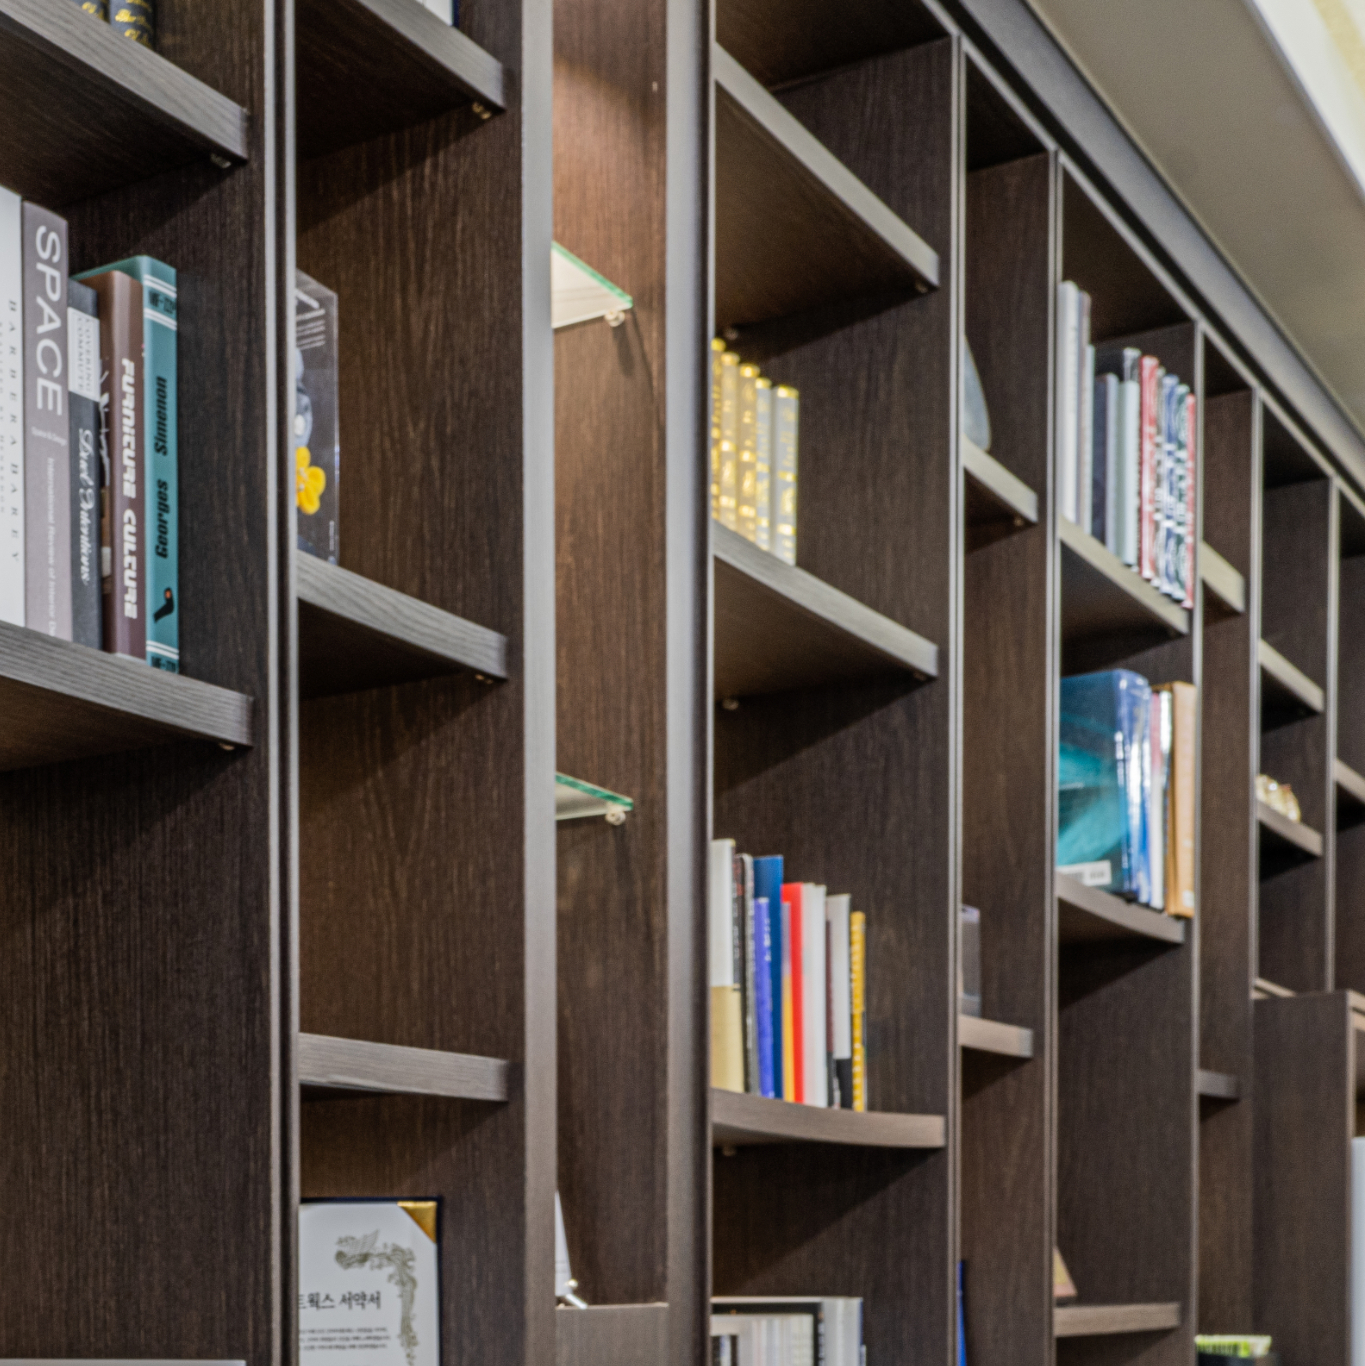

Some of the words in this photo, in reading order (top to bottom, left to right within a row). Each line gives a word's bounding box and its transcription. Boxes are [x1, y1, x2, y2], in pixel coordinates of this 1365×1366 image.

[35, 225, 63, 416] SPACE
[155, 376, 168, 456] Simenon
[155, 479, 170, 558] Georges
